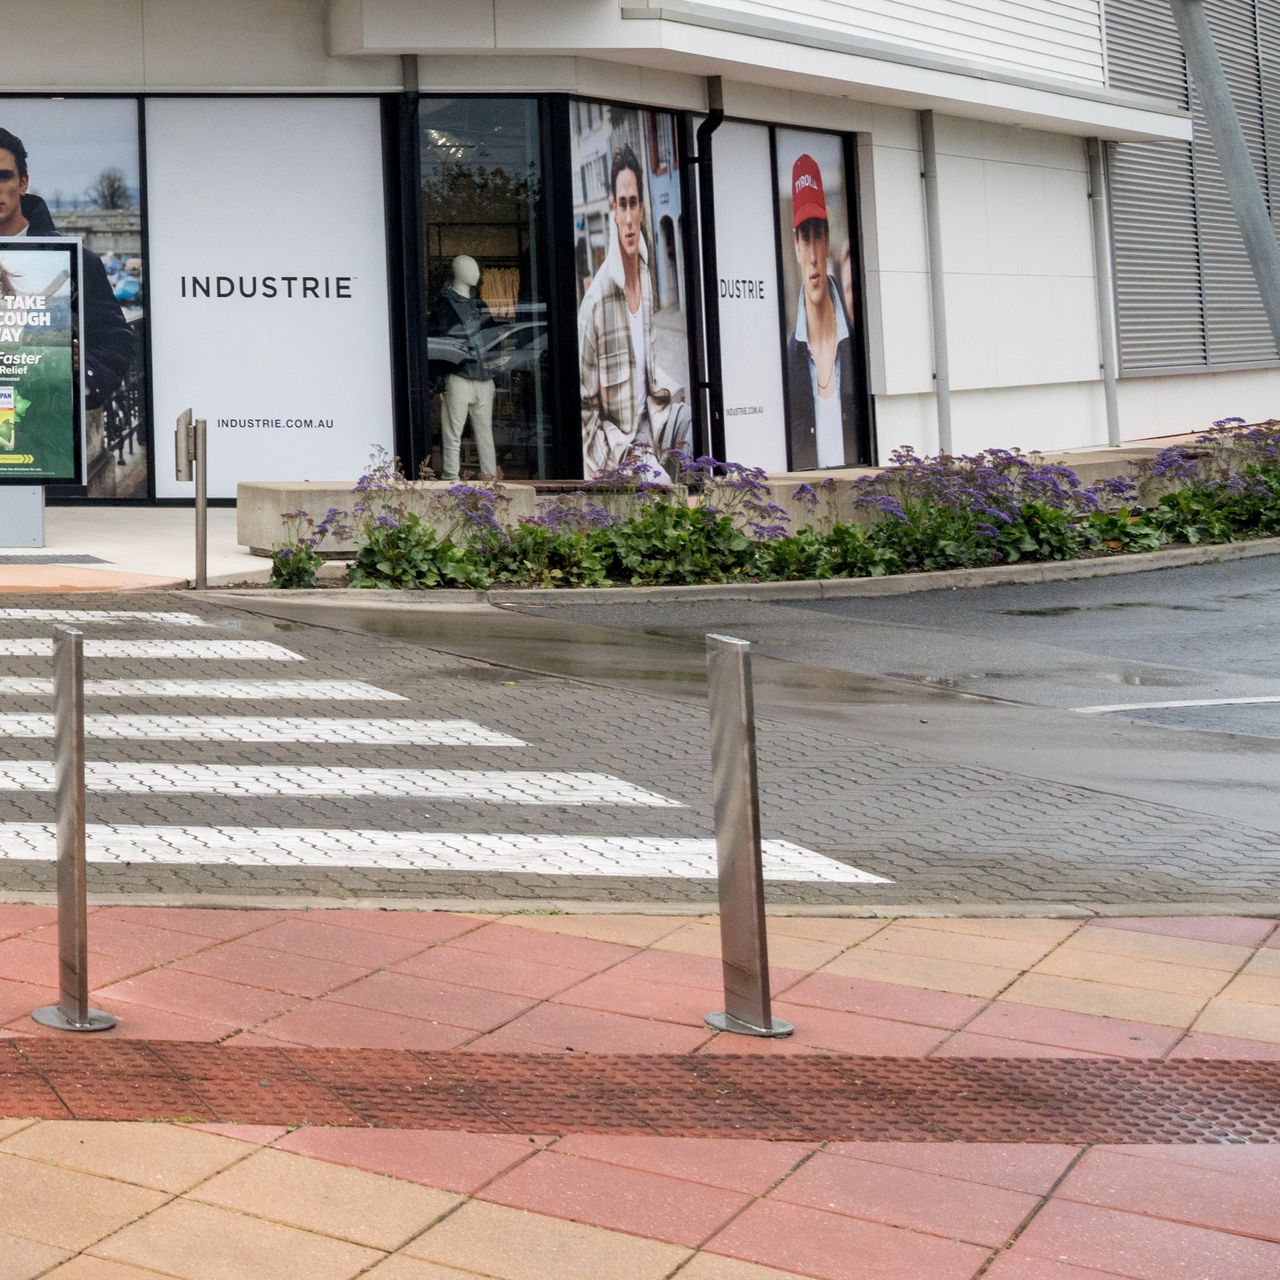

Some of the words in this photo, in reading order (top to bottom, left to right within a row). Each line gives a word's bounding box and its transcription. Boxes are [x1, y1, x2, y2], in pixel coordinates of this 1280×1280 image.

[181, 276, 352, 299] INDUSTRIE
[720, 278, 764, 300] DUSTRIE
[3, 296, 46, 309] TAKE
[0, 365, 28, 374] Relief
[217, 419, 334, 428] INDUSTRIE.COM.AU
